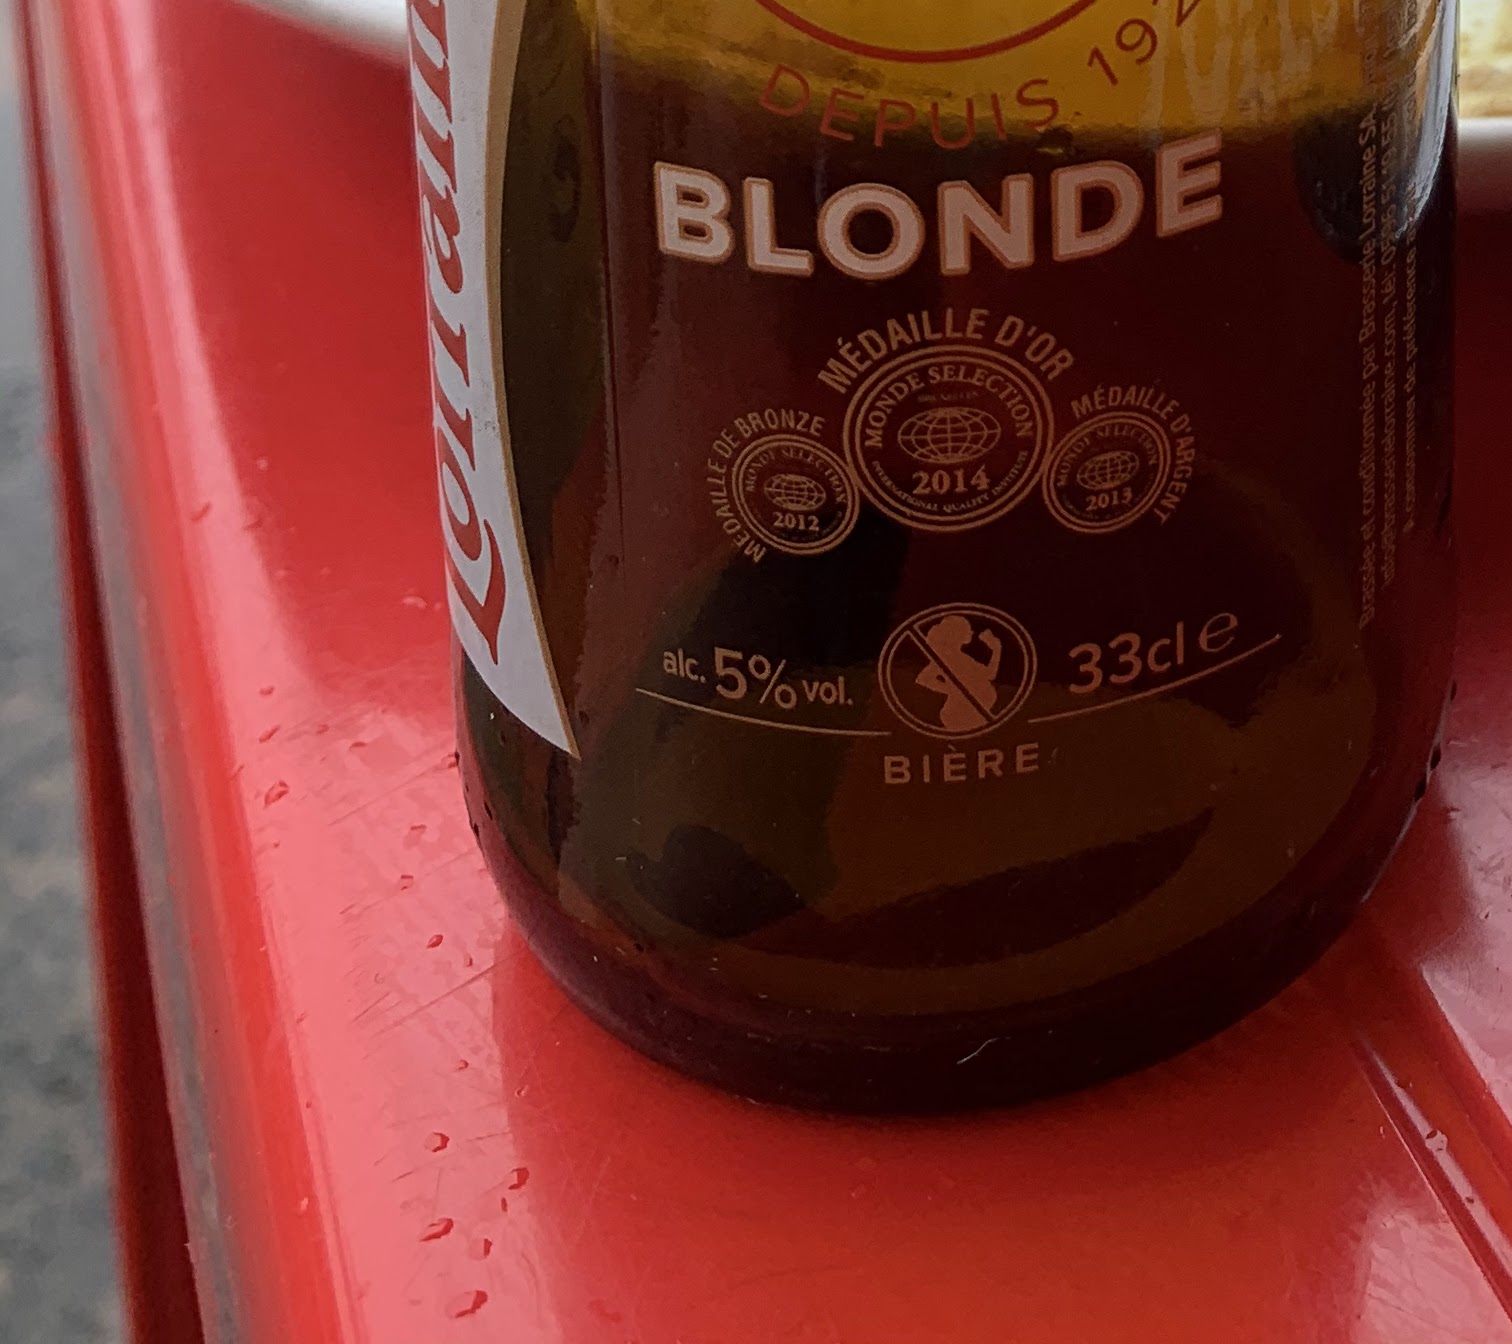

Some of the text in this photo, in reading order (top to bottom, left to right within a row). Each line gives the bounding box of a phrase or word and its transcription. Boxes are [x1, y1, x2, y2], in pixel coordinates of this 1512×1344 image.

[757, 62, 1060, 150] DEPUIS
[652, 131, 1224, 279] BLONDE
[1357, 144, 1377, 240] Lorraine
[1357, 239, 1377, 343] Brasserie
[818, 307, 1075, 394] MÉDAILLE D'OR
[1360, 344, 1380, 379] par
[712, 428, 742, 459] DE
[733, 407, 827, 438] BRONZE
[864, 364, 1034, 449] MONDE SELECTION
[912, 463, 991, 495] 2014
[1084, 485, 1134, 512] 2013
[772, 510, 821, 533] 2012
[662, 647, 707, 686] alc.
[1067, 621, 1186, 695] 33cl
[883, 744, 1041, 785] BIÈRE
